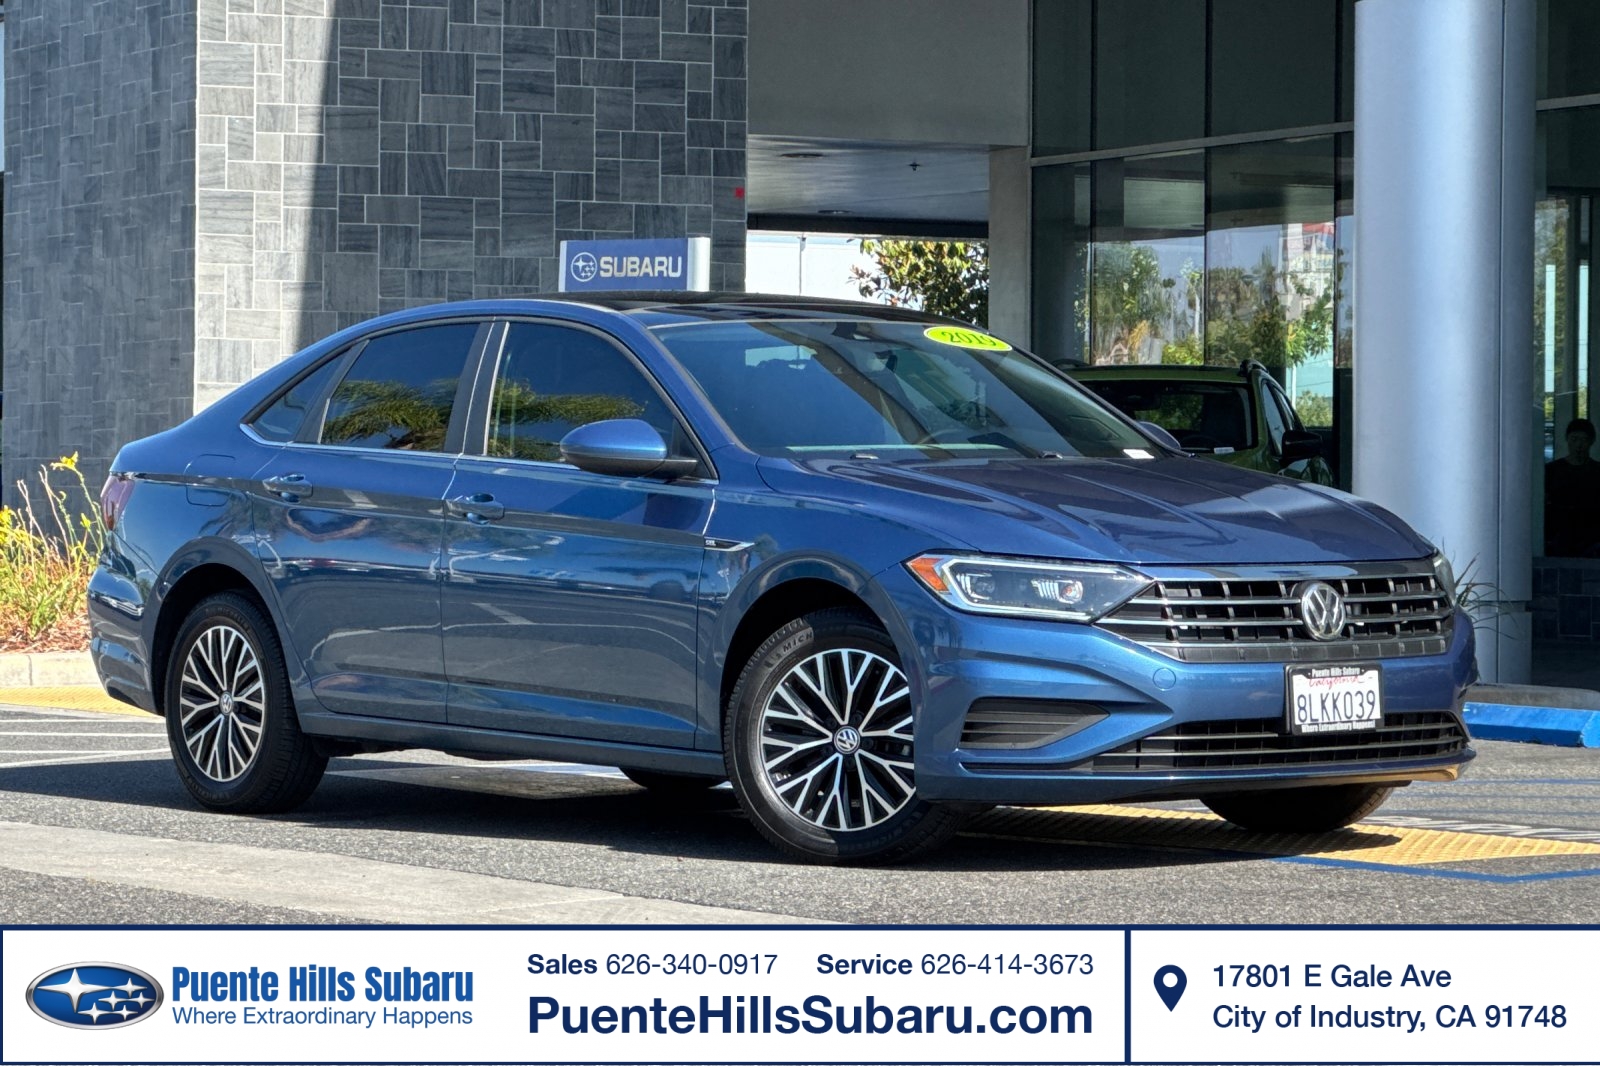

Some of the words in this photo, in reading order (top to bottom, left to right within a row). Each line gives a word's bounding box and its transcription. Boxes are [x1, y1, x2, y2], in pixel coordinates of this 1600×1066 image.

[600, 256, 682, 278] SUBARU
[941, 331, 997, 347] 2019
[1297, 690, 1376, 723] 8LKK039
